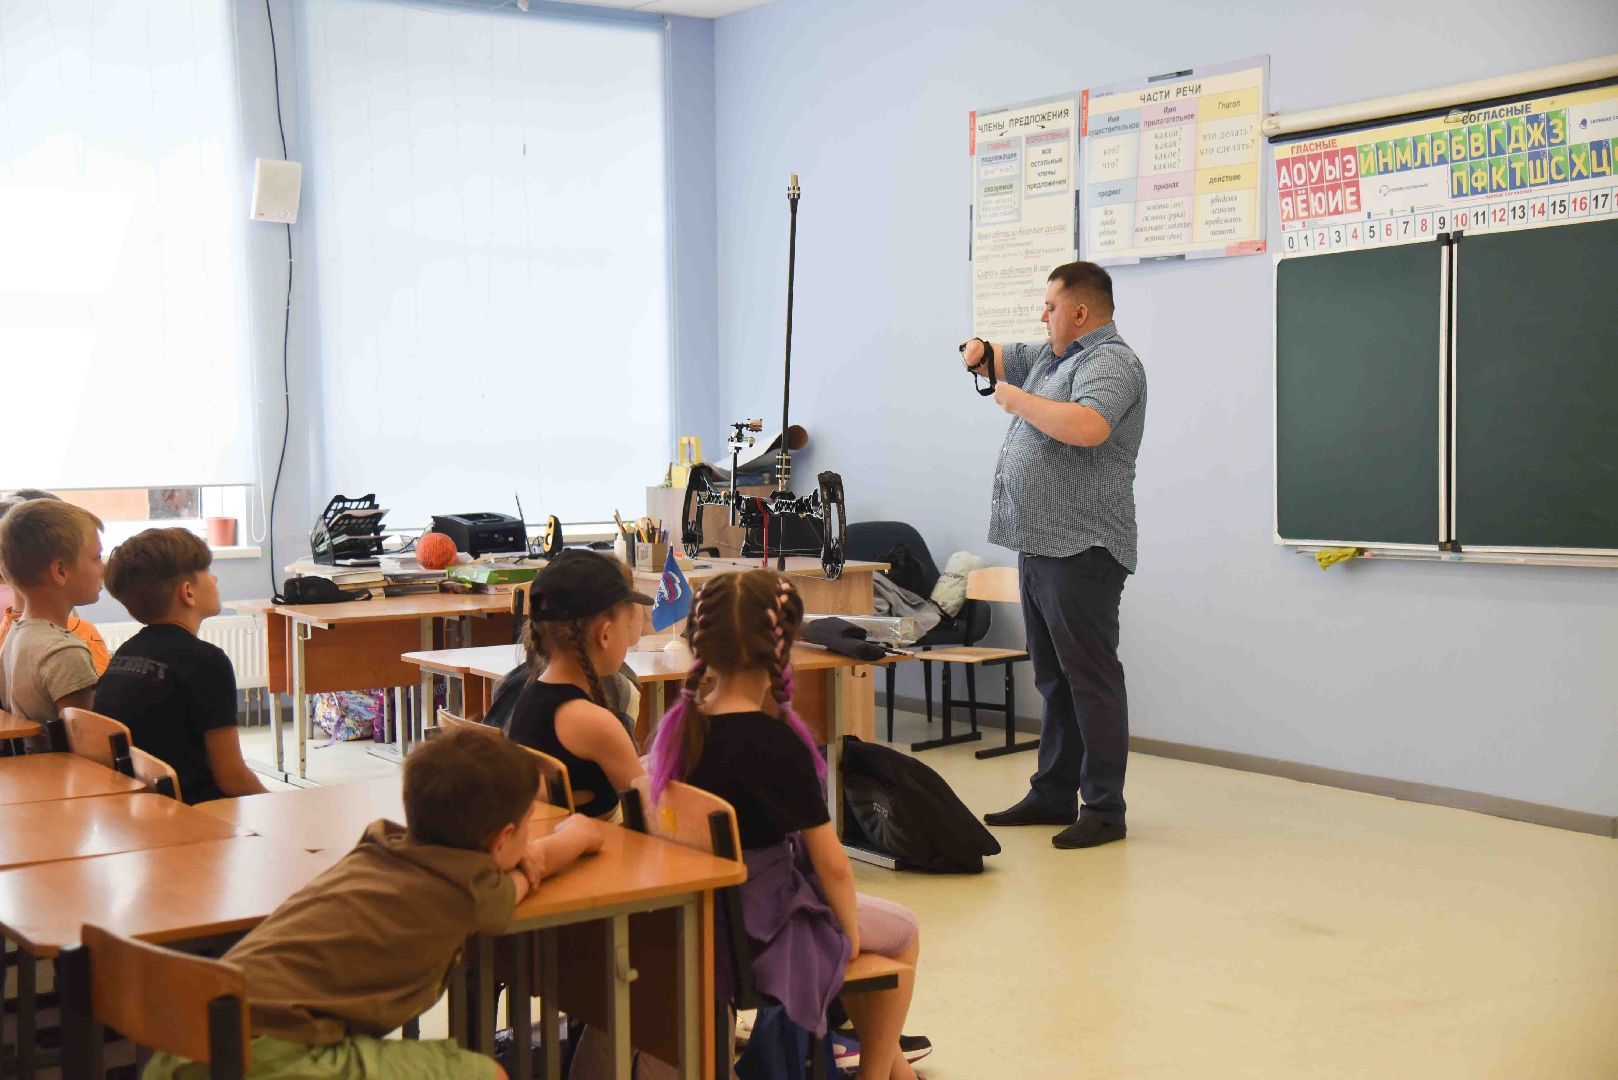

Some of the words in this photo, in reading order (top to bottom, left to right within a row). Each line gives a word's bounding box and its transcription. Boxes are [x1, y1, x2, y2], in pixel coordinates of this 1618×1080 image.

[1140, 90, 1170, 103] ЧАСТИ
[1176, 84, 1201, 97] РЕЧИ
[1218, 100, 1241, 110] Глагол
[1462, 103, 1532, 124] СОГЛАСНЫЕ
[979, 121, 1005, 133] ЧЛЕНЫ
[1009, 108, 1069, 128] ПРЕДЛОЖЕНИЯ
[1107, 115, 1120, 123] Имя
[1144, 113, 1195, 128] прилагательное
[1290, 138, 1338, 155] ГЛАСНЫЕ
[1209, 174, 1241, 185] действие
[1288, 236, 1294, 249] 0
[1303, 234, 1309, 247] 1
[1319, 232, 1325, 246] 2
[1334, 230, 1341, 243] 3
[1351, 228, 1358, 241] 4
[1369, 225, 1376, 239] 5
[1385, 223, 1393, 237] 6
[1402, 221, 1409, 234] 7
[1420, 218, 1428, 232] 8
[1438, 216, 1446, 230] 9
[1454, 213, 1468, 227] 10
[1473, 210, 1486, 225] 11
[1491, 207, 1506, 223] 12
[1510, 204, 1526, 220] 13
[1530, 202, 1546, 218] 14
[1550, 199, 1567, 215] 15
[1571, 196, 1588, 212] 16
[1592, 193, 1609, 209] 17
